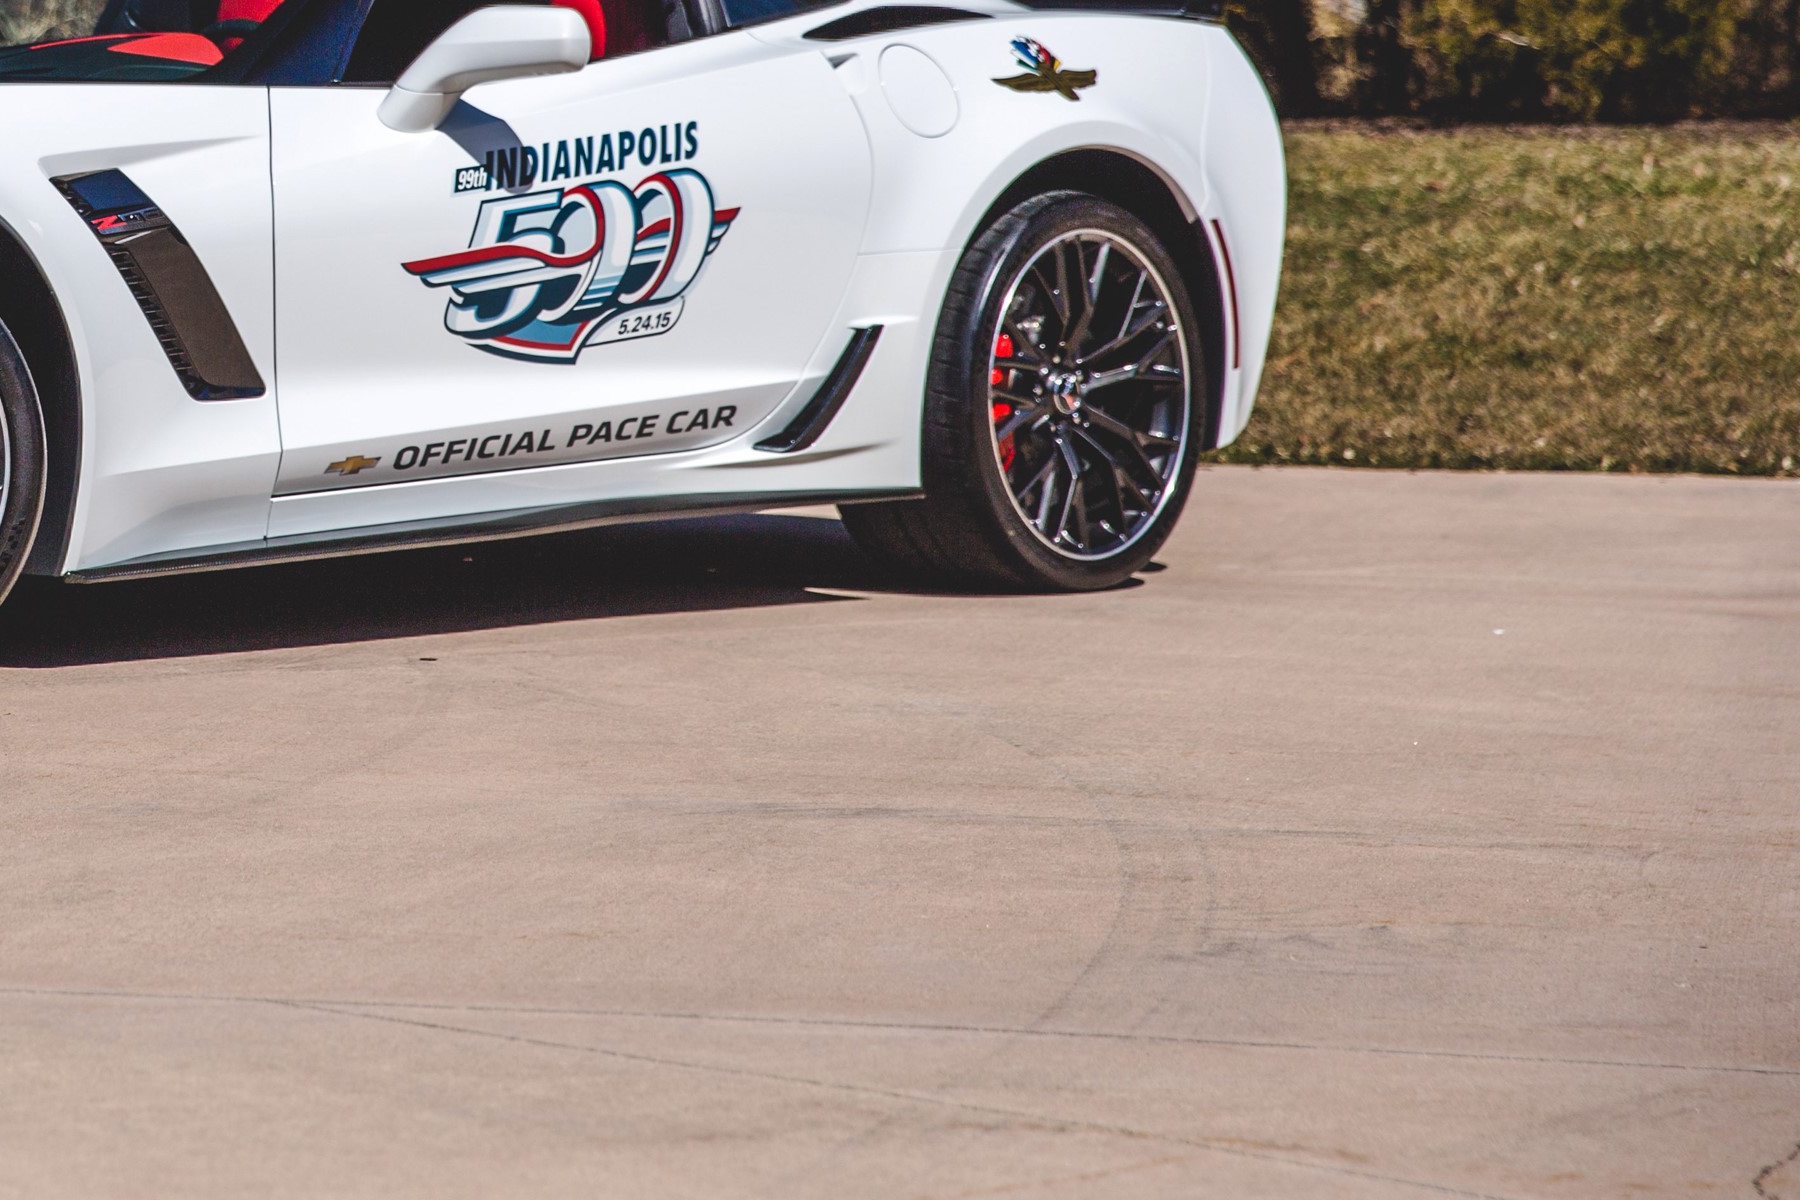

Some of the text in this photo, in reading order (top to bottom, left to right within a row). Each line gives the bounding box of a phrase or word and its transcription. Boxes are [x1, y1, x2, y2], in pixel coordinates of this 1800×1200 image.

[457, 167, 488, 191] 99th
[485, 121, 699, 191] INDIANAPOLIS
[444, 167, 716, 339] 500
[617, 311, 672, 335] 5.24.15
[392, 404, 738, 471] OFFICIAL PACE CAR
